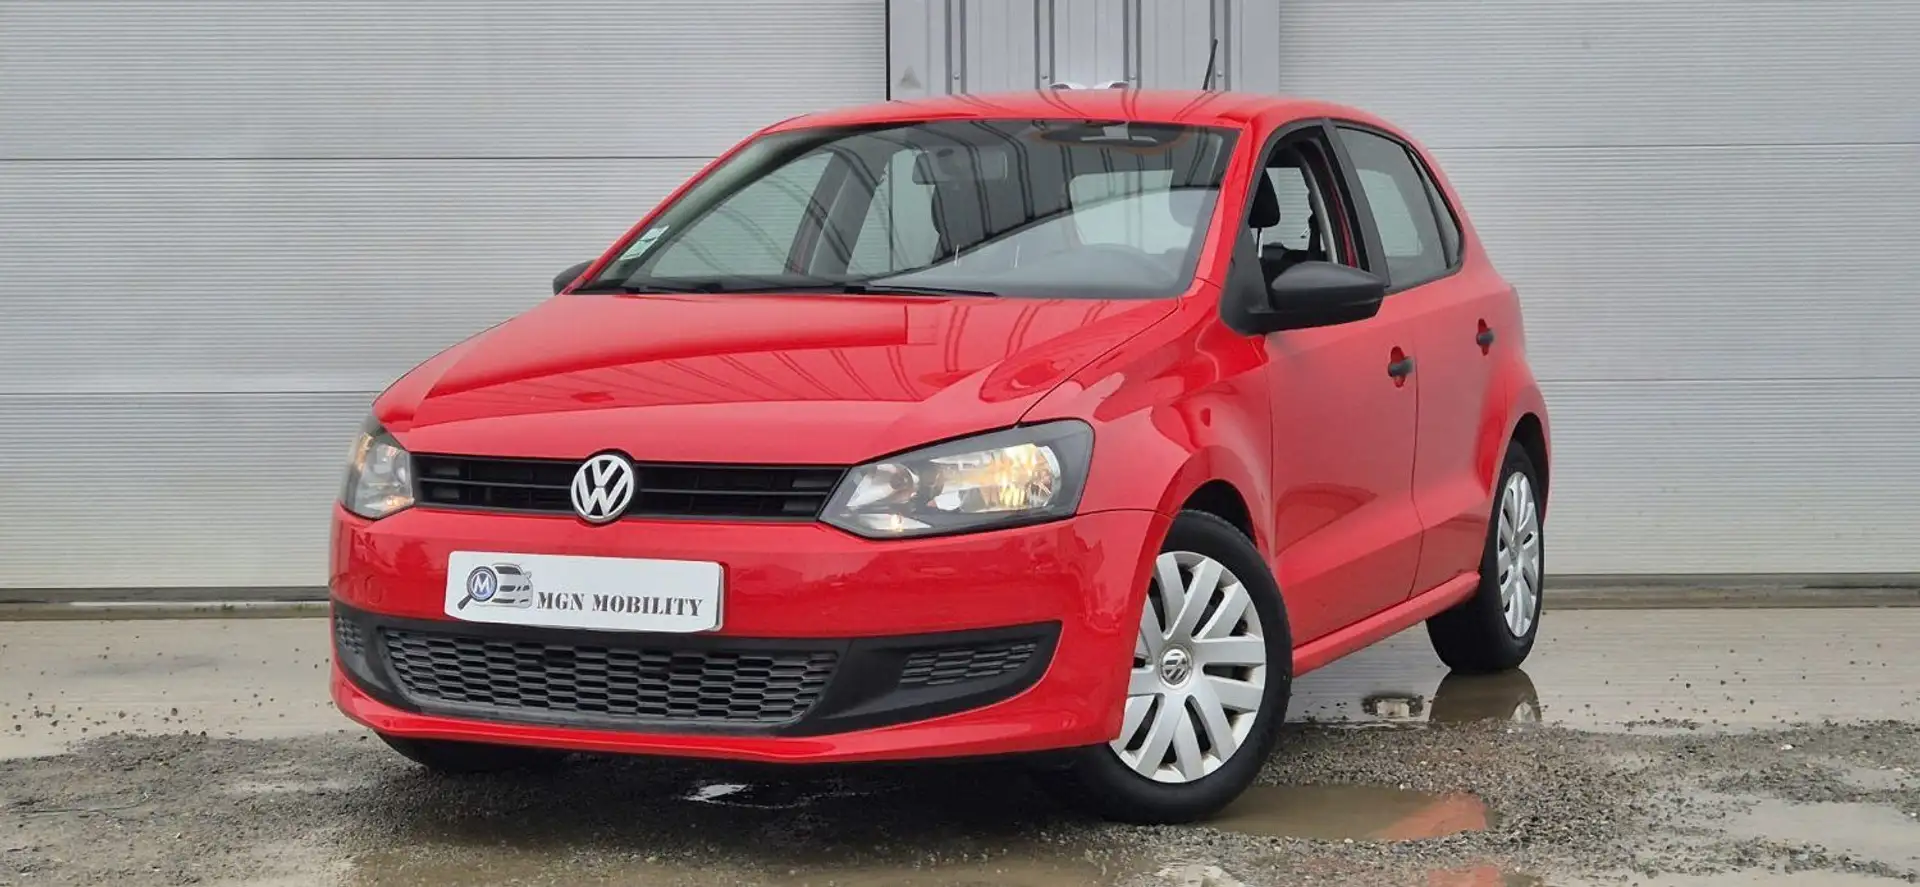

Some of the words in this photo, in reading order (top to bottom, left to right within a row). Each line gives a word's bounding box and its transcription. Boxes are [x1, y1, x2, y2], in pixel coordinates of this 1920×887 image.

[571, 455, 634, 520] VW
[472, 575, 491, 592] M
[537, 591, 584, 611] MGN
[593, 594, 702, 616] MOBILITY
